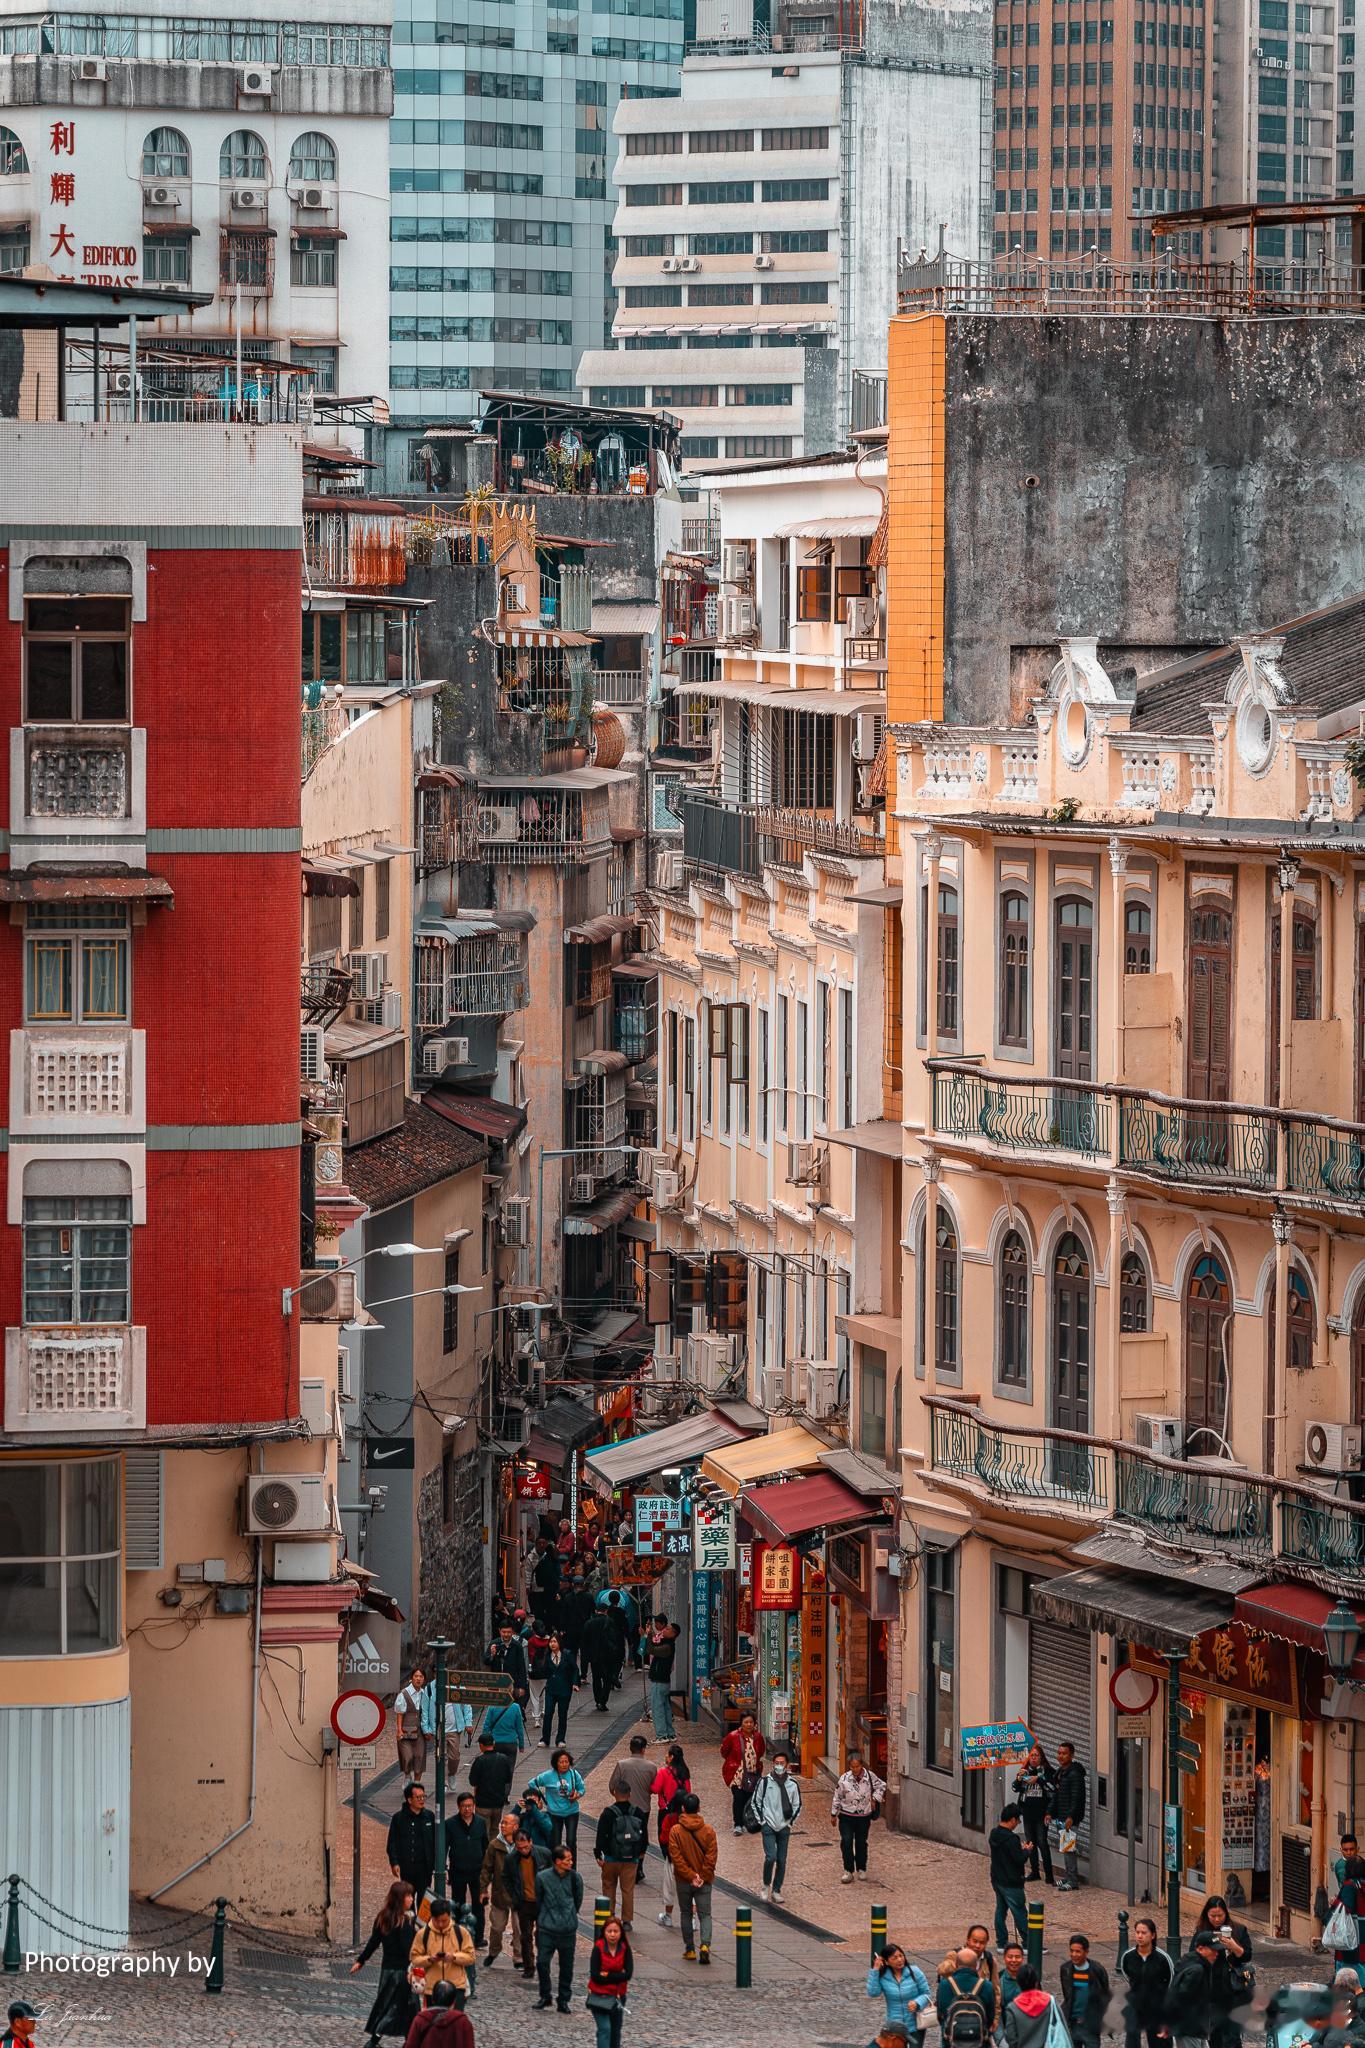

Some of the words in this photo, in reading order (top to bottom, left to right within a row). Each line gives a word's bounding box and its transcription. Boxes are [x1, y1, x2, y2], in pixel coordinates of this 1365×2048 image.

[83, 246, 137, 266] EDIFICIO
[521, 1486, 547, 1498] 餅家
[638, 1510, 680, 1520] 仁濟藥房
[667, 1534, 692, 1553] 老澳
[700, 1526, 730, 1568] 藥房
[765, 1553, 776, 1577] 餅家
[779, 1553, 790, 1589] 咀香園
[695, 1571, 707, 1669] 府註冊信心保證
[338, 1658, 390, 1674] didas
